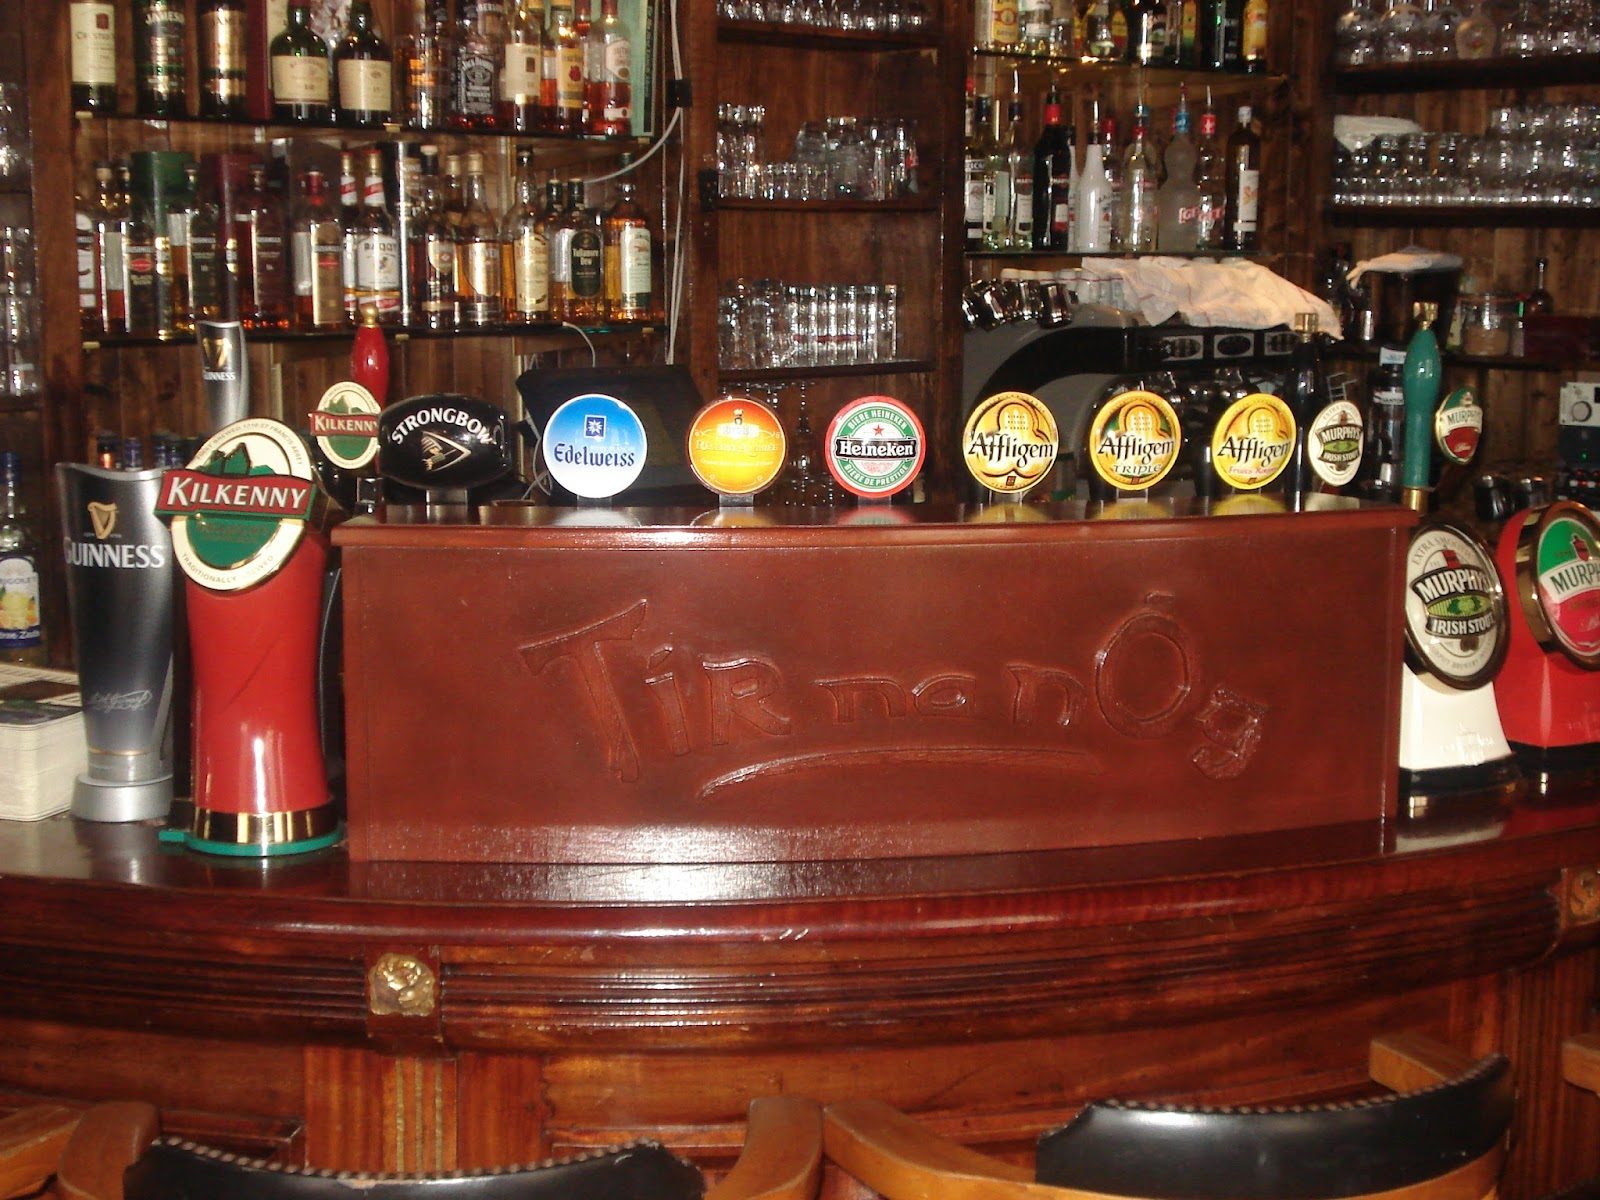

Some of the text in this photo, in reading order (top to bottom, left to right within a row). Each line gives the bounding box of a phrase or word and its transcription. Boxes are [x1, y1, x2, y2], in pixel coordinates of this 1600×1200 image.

[391, 407, 494, 445] STRONGBOW
[871, 409, 908, 430] HEINEKEN
[554, 443, 635, 467] Edelweiss
[839, 440, 914, 457] Heineken
[968, 432, 1054, 468] Affligem
[1097, 434, 1175, 465] Affligem
[1217, 435, 1292, 467] Affligem
[167, 476, 307, 509] KILKENNY
[1431, 612, 1494, 636] IRISH STOUT
